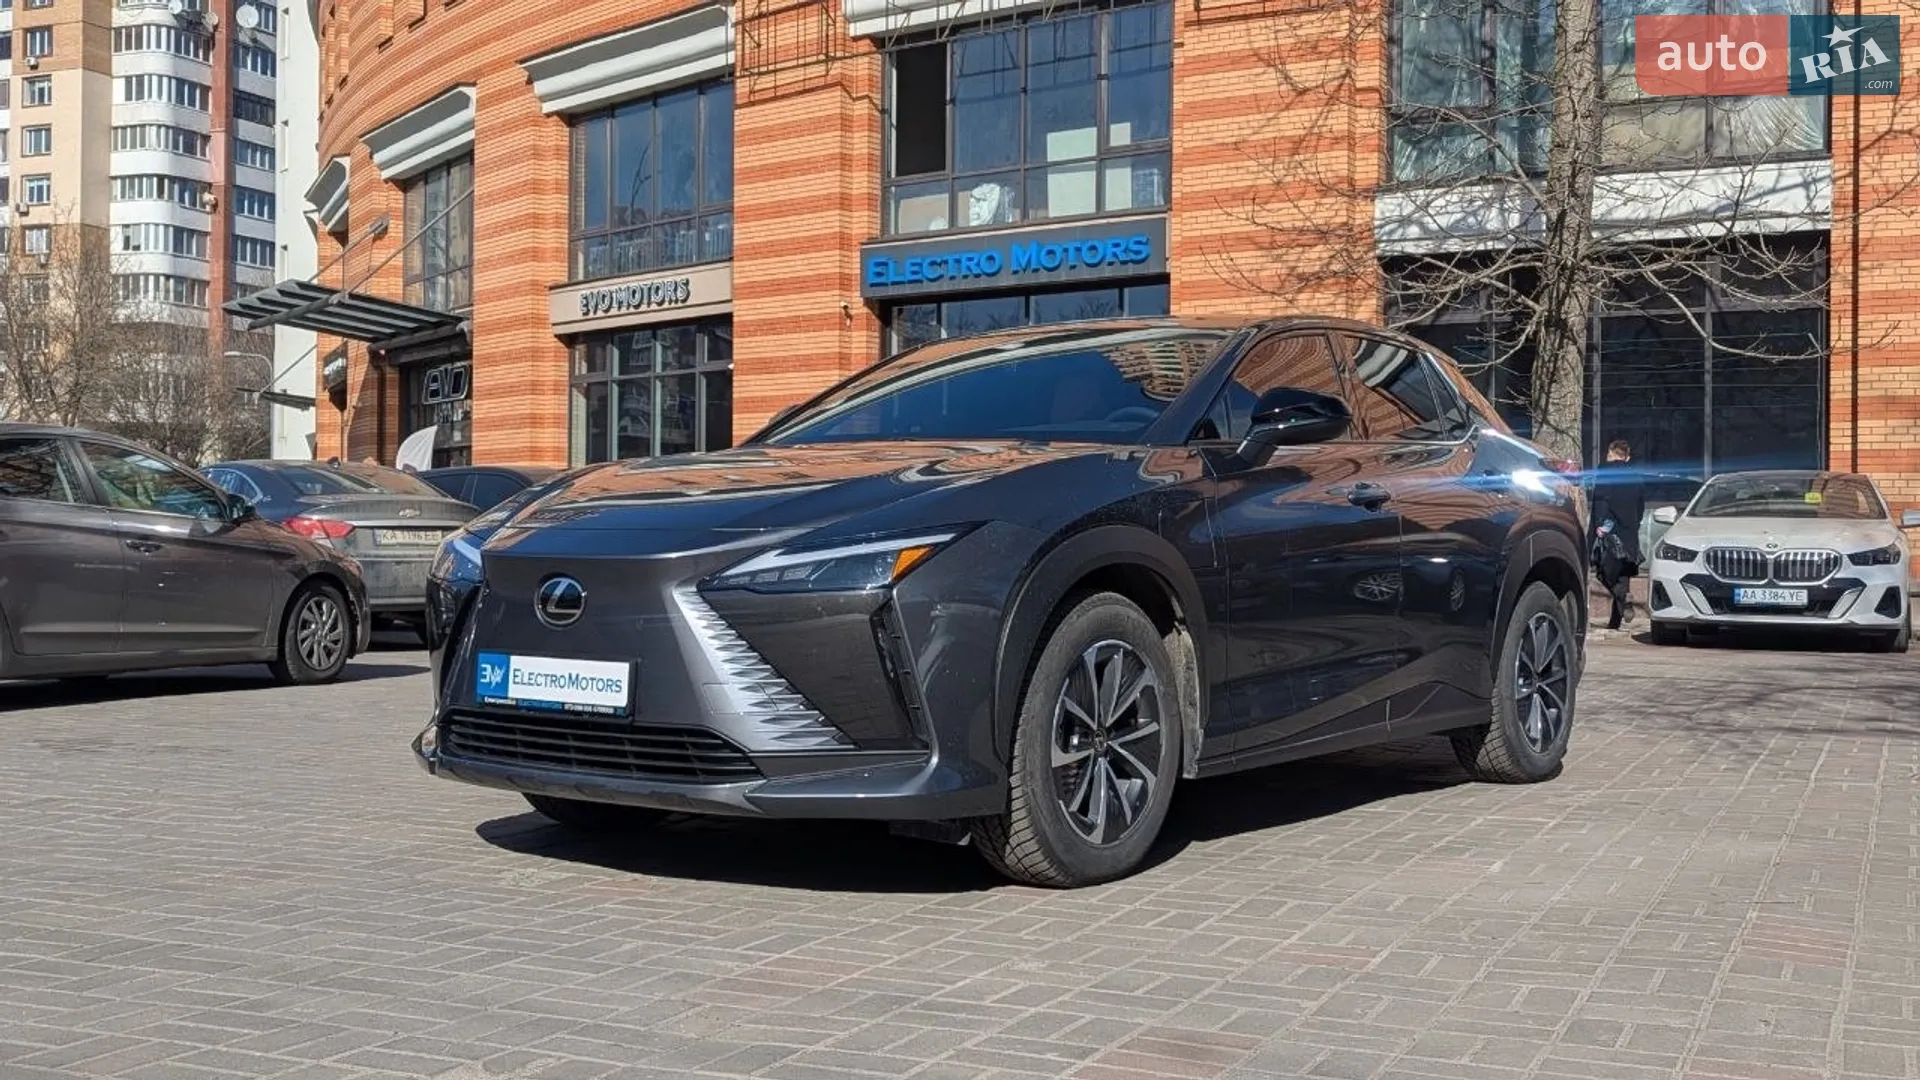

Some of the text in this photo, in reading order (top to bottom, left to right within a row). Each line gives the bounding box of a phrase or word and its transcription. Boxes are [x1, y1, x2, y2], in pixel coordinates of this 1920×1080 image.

[868, 235, 1150, 287] ELECTRO MOTORS
[580, 277, 691, 316] EVO MOTORS
[1742, 589, 1805, 601] AA 3384 YE
